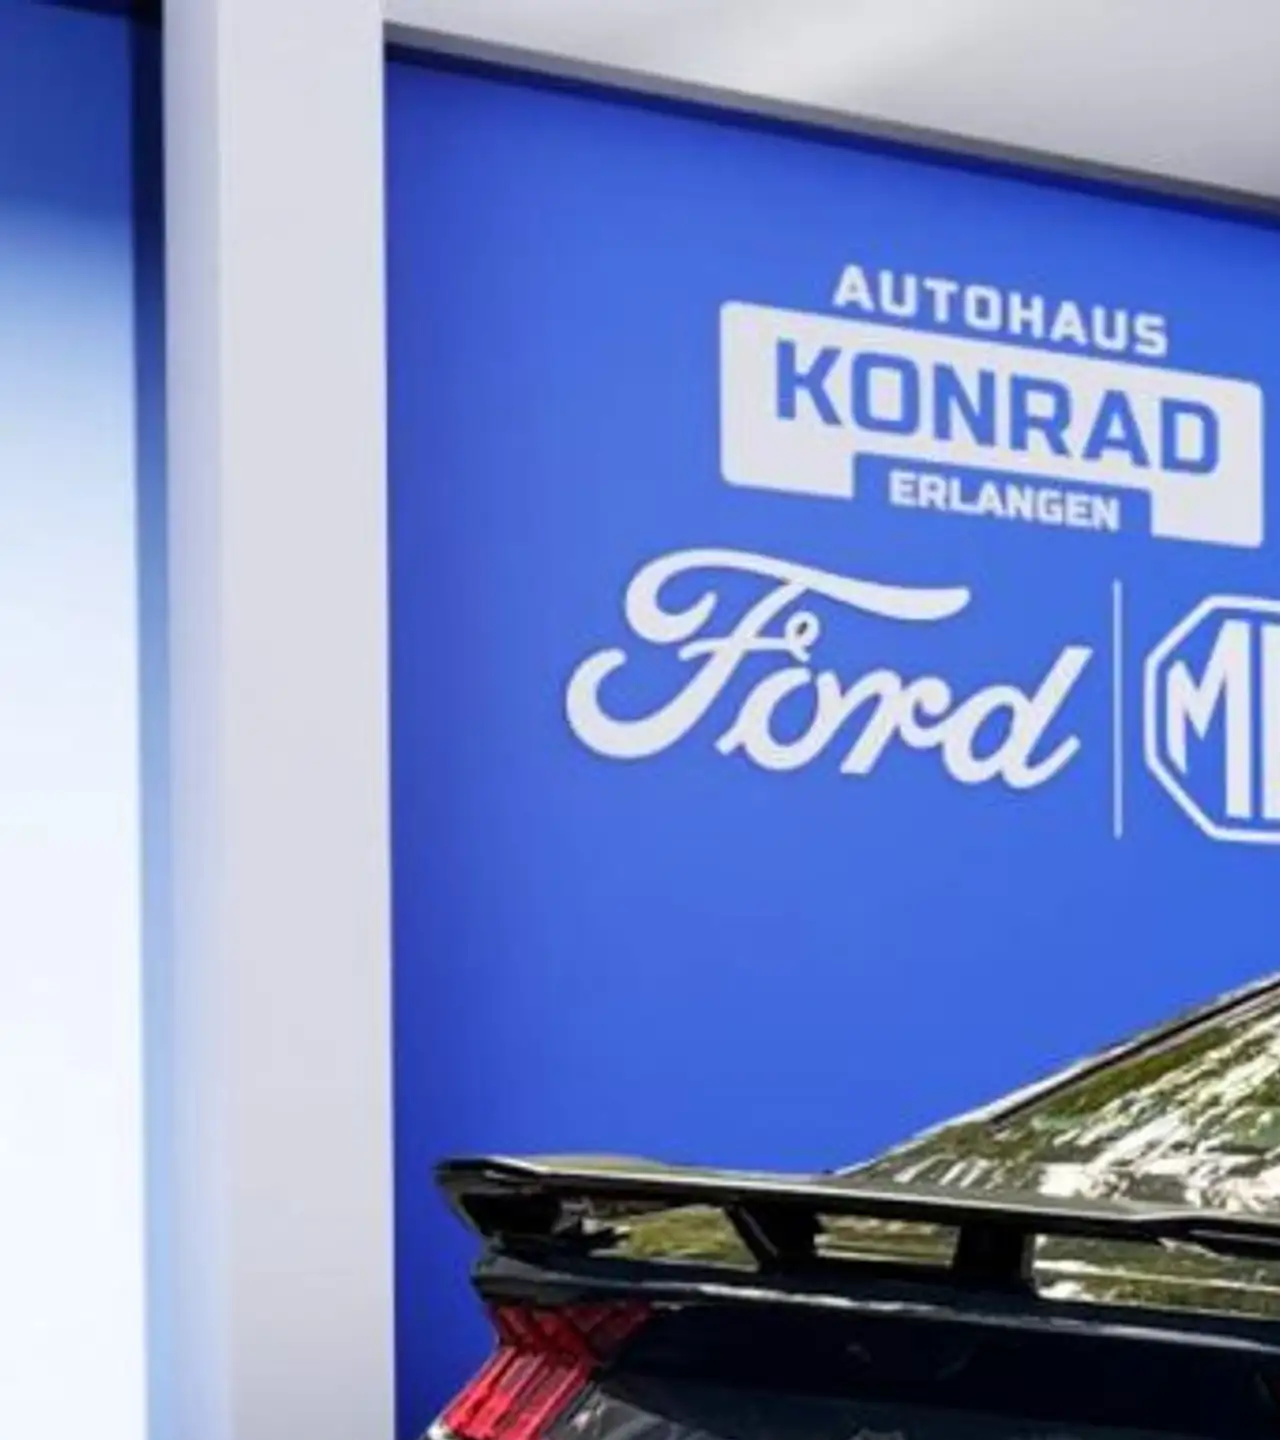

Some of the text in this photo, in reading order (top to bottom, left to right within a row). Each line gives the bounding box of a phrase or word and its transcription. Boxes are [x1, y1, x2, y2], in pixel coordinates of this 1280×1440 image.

[832, 263, 1170, 359] AUTOHAUS
[774, 337, 1222, 477] KONRAD
[887, 468, 1121, 533] ERLANGEN
[564, 546, 1094, 791] Ford
